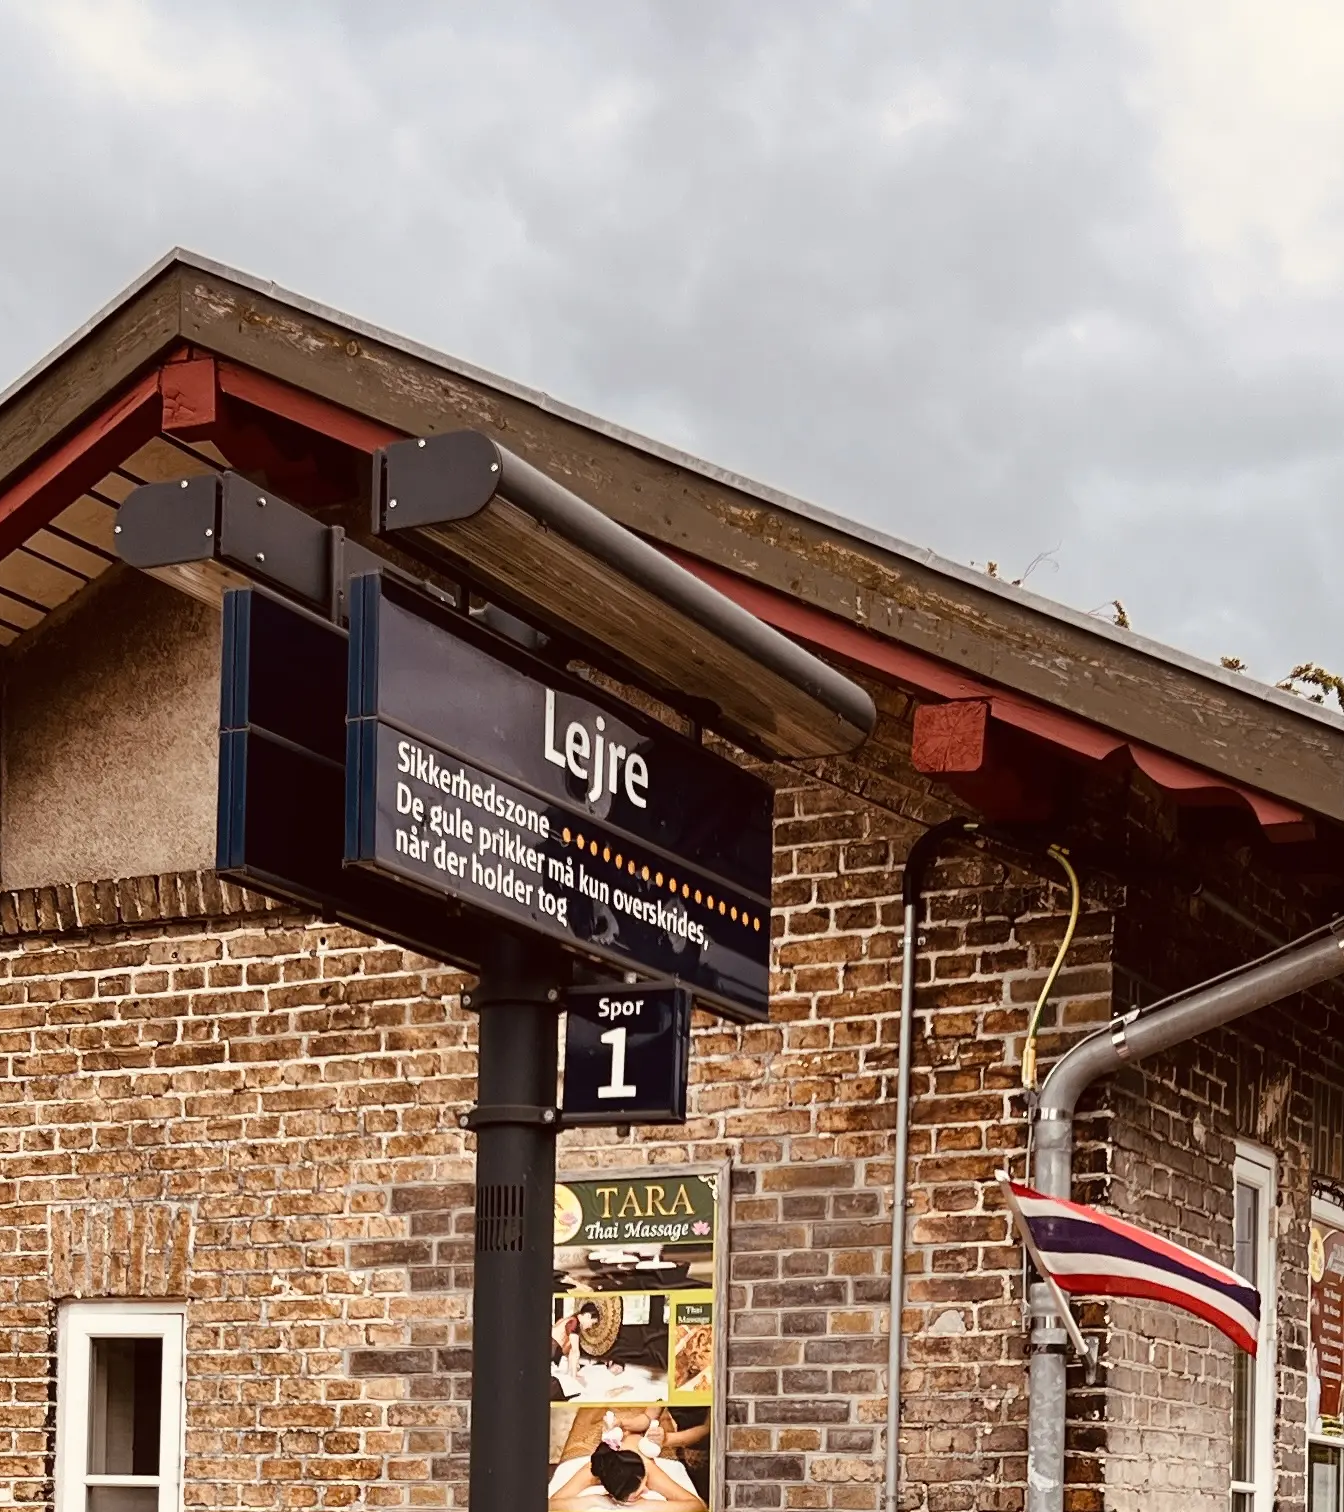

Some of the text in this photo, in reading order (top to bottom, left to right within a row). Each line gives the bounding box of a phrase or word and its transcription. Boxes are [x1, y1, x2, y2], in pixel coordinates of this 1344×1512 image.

[397, 740, 550, 839] Sikkerhedszone
[544, 688, 650, 809] Lejre
[395, 825, 568, 928] når der holder tog
[396, 781, 709, 951] De gule prikker må kun overskrides,
[598, 997, 644, 1020] Spor
[597, 1026, 638, 1100] 1
[584, 1220, 690, 1242] Thai Massage
[595, 1183, 695, 1219] TARA
